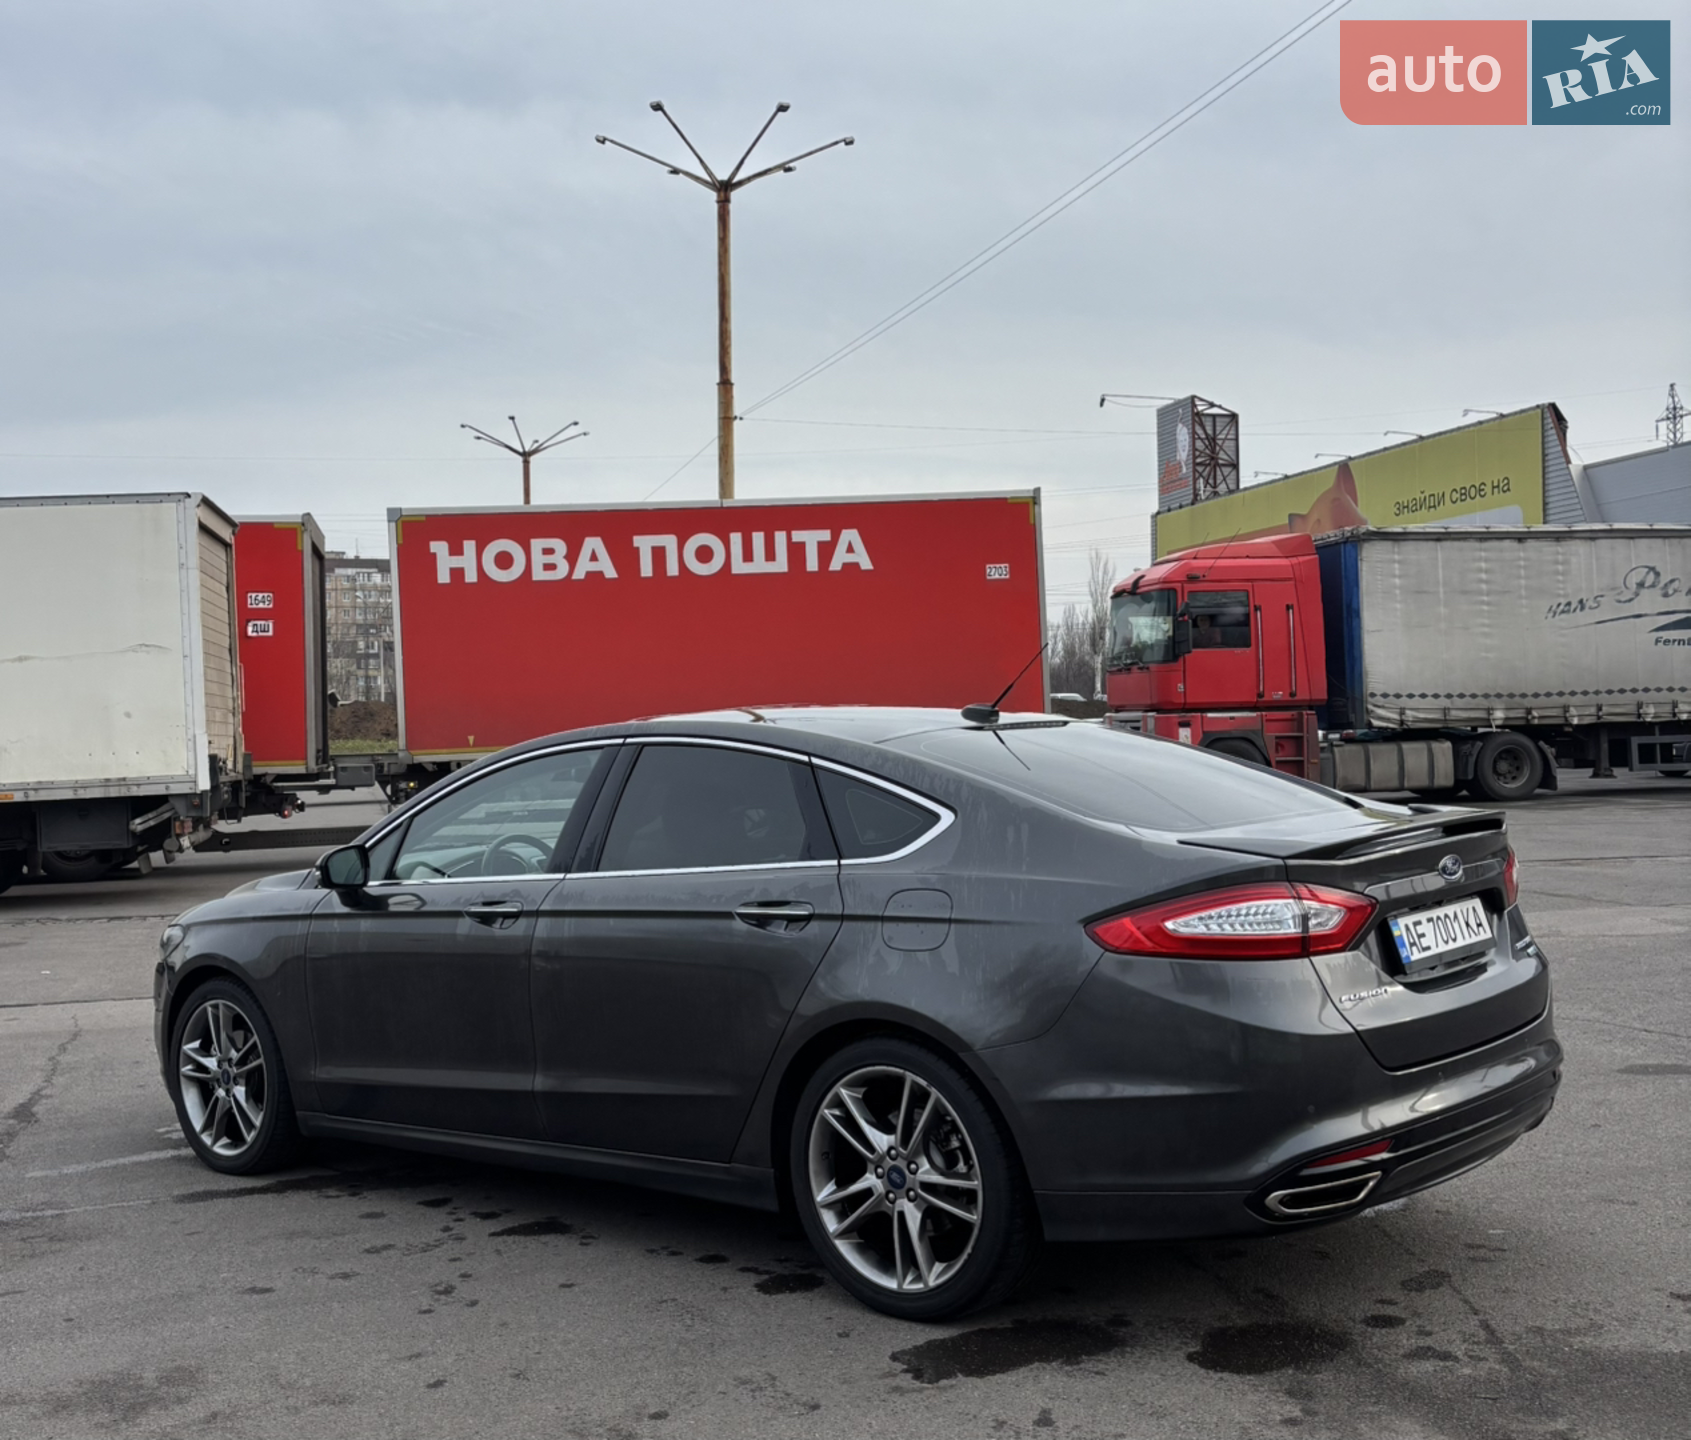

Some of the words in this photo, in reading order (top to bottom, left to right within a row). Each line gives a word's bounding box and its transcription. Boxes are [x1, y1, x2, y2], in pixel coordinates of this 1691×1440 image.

[1393, 490, 1446, 517] знайди
[1449, 481, 1488, 505] своє
[1491, 476, 1511, 496] на
[429, 536, 618, 584] НОВА
[633, 529, 875, 578] ПОШТА
[248, 594, 272, 606] 1649
[1545, 594, 1605, 620] HANS
[1613, 564, 1691, 604] Po
